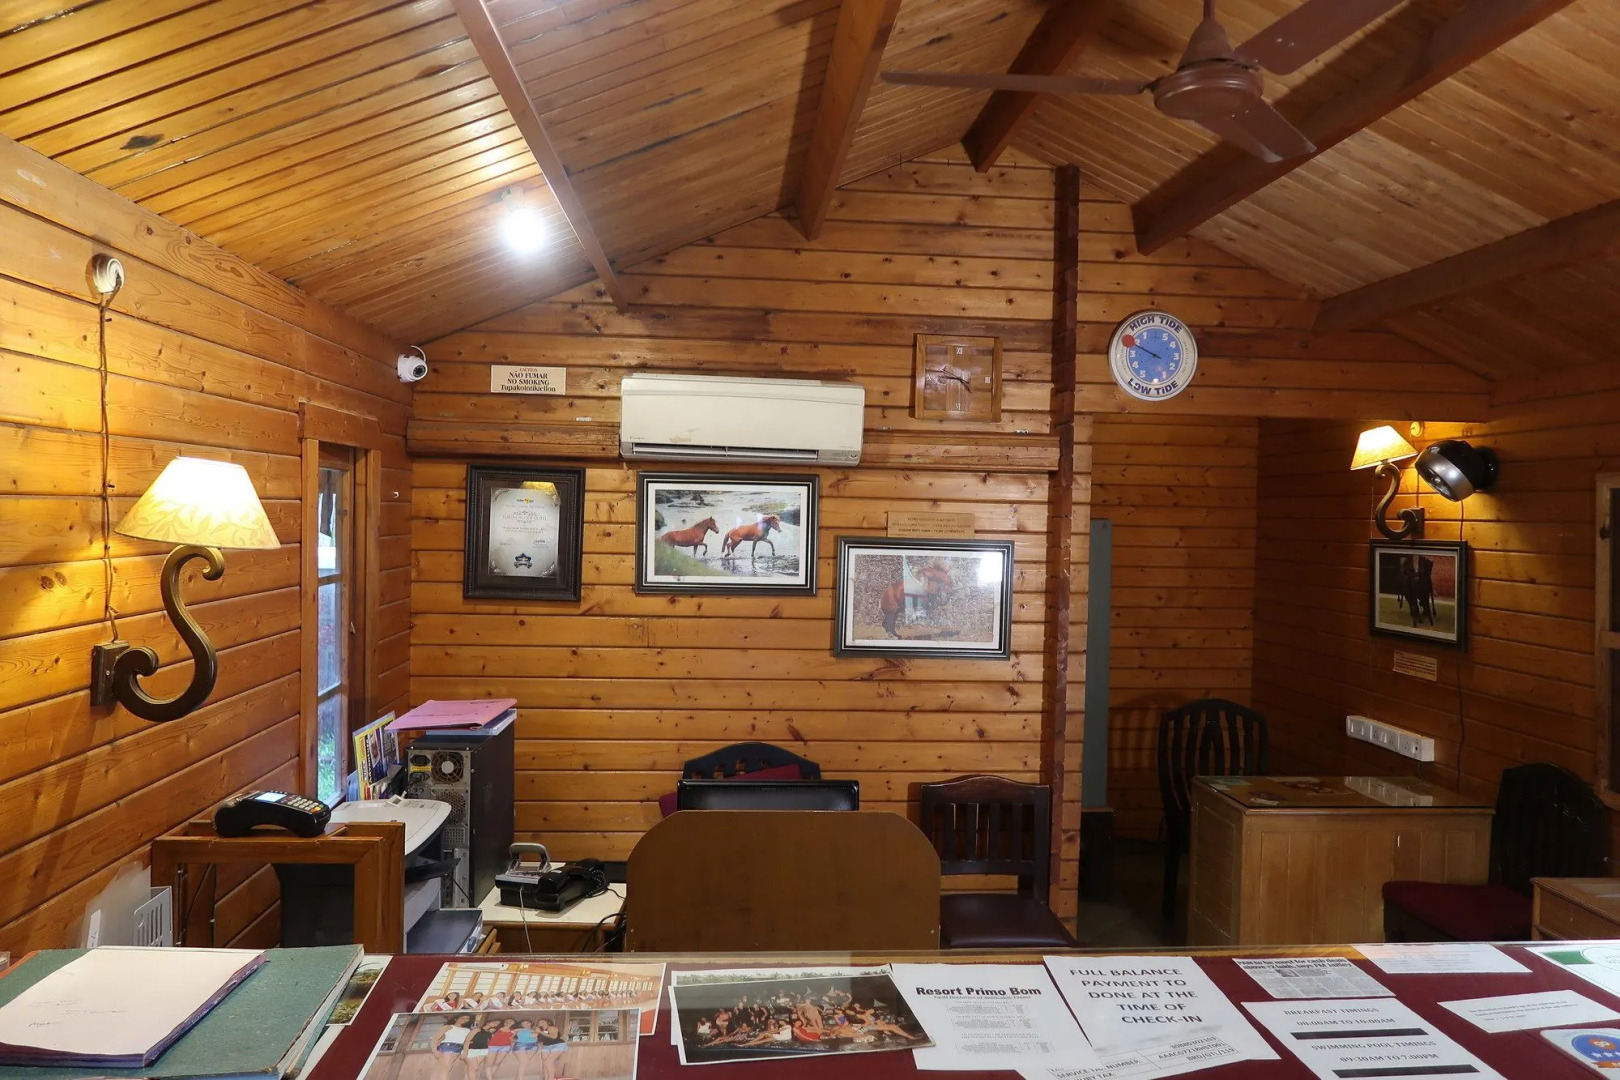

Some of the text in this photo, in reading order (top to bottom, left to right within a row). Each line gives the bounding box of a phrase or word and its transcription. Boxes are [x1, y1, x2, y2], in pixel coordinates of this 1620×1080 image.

[1130, 317, 1155, 331] HIGH
[1162, 333, 1169, 341] 5
[1129, 350, 1136, 358] 3
[1173, 352, 1179, 360] 3
[1132, 361, 1139, 369] 4
[1140, 370, 1146, 378] 5
[1162, 371, 1167, 379] 1
[1128, 378, 1151, 395] LOW
[915, 987, 1042, 996] Resort Primo Bom
[1164, 1003, 1187, 1011] OF
[1283, 1007, 1380, 1016] BREAKFAST TIMINGS
[1121, 1015, 1203, 1024] CHECK-IN
[1311, 1043, 1366, 1051] SWIMMING
